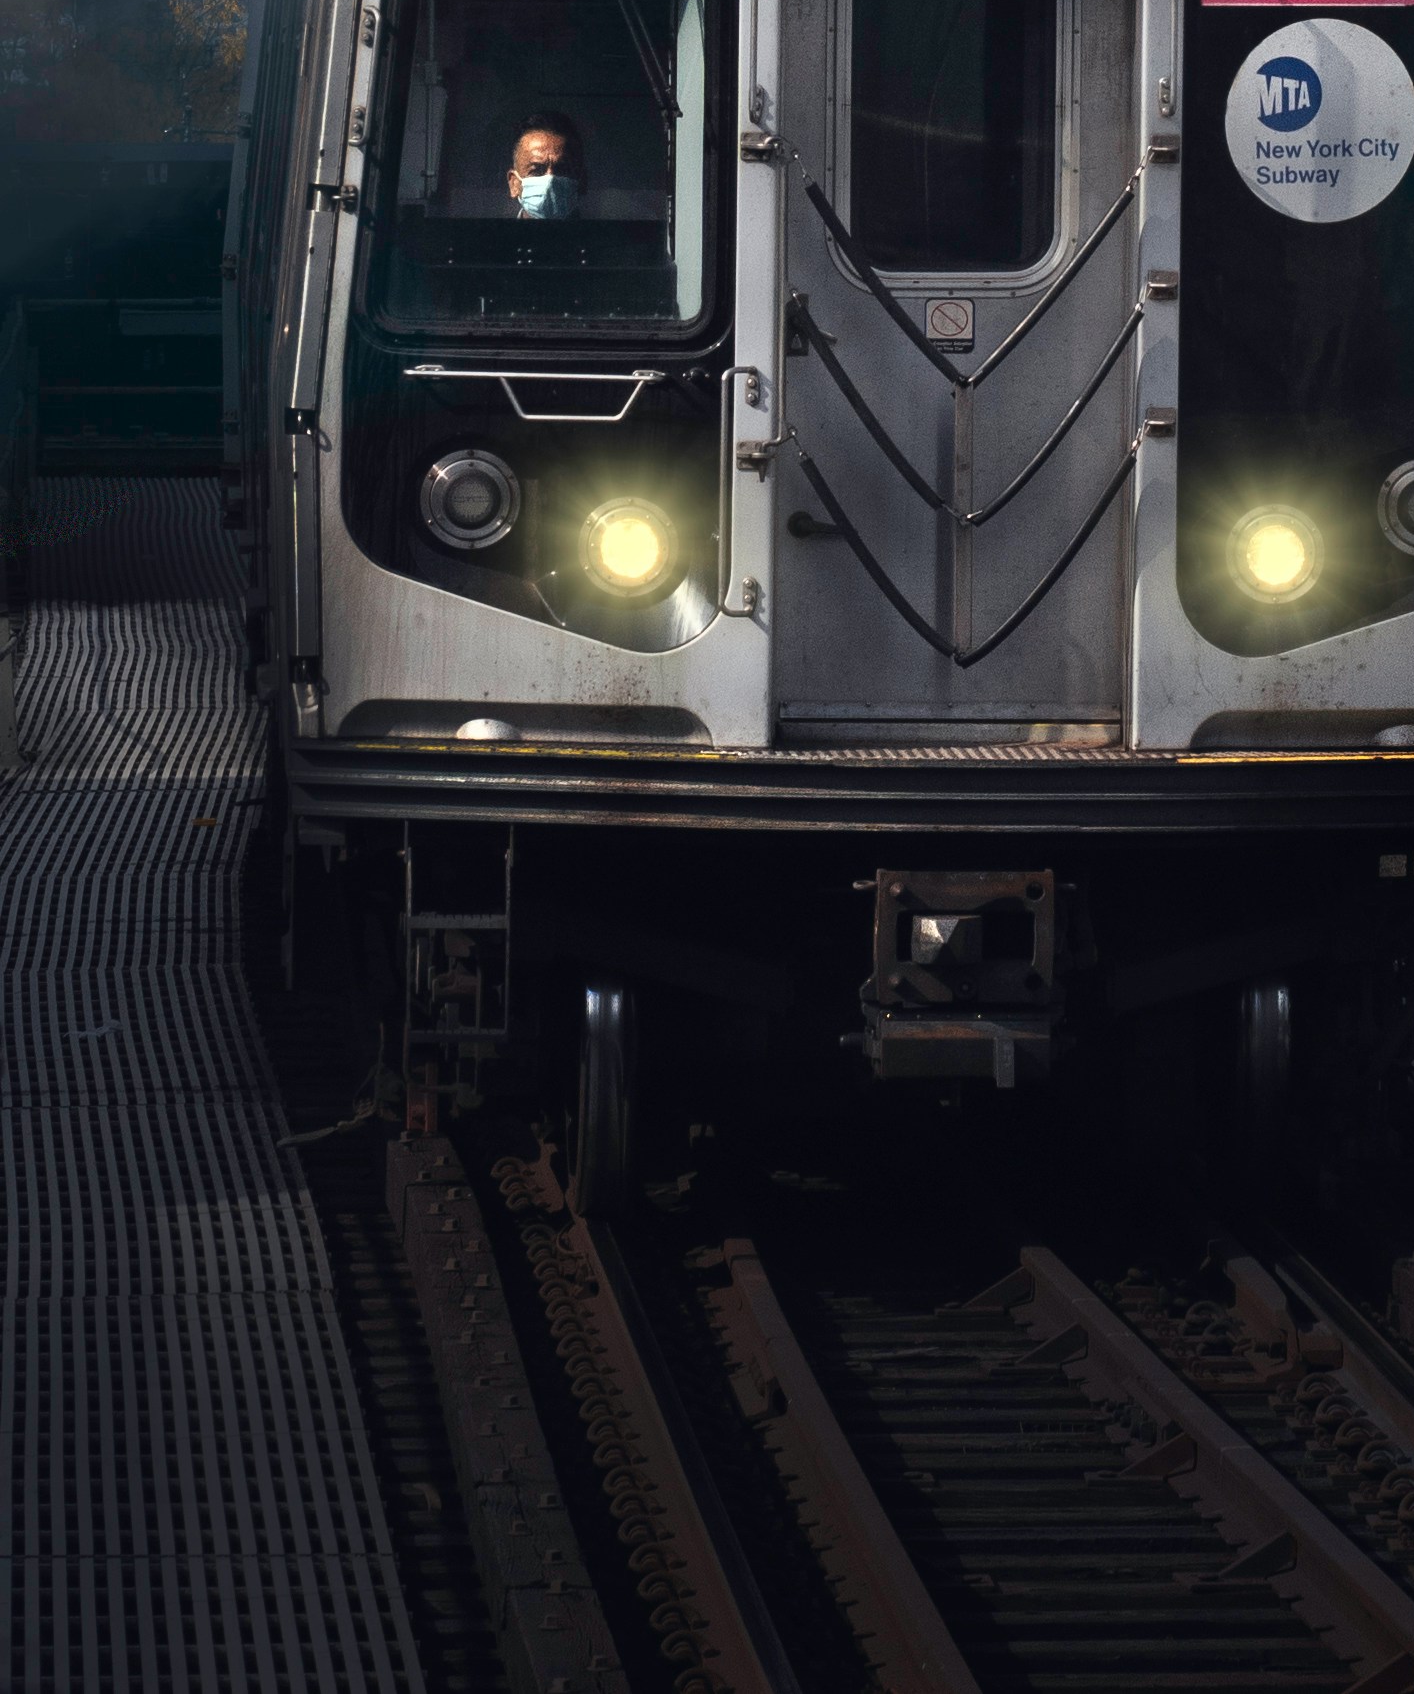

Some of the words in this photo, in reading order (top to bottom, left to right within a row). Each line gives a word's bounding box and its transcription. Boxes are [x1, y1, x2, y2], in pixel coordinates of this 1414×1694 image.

[1256, 73, 1311, 118] MTA
[1256, 140, 1302, 159] New
[1306, 140, 1353, 158] York
[1358, 138, 1400, 162] City
[1256, 165, 1340, 187] Subway
